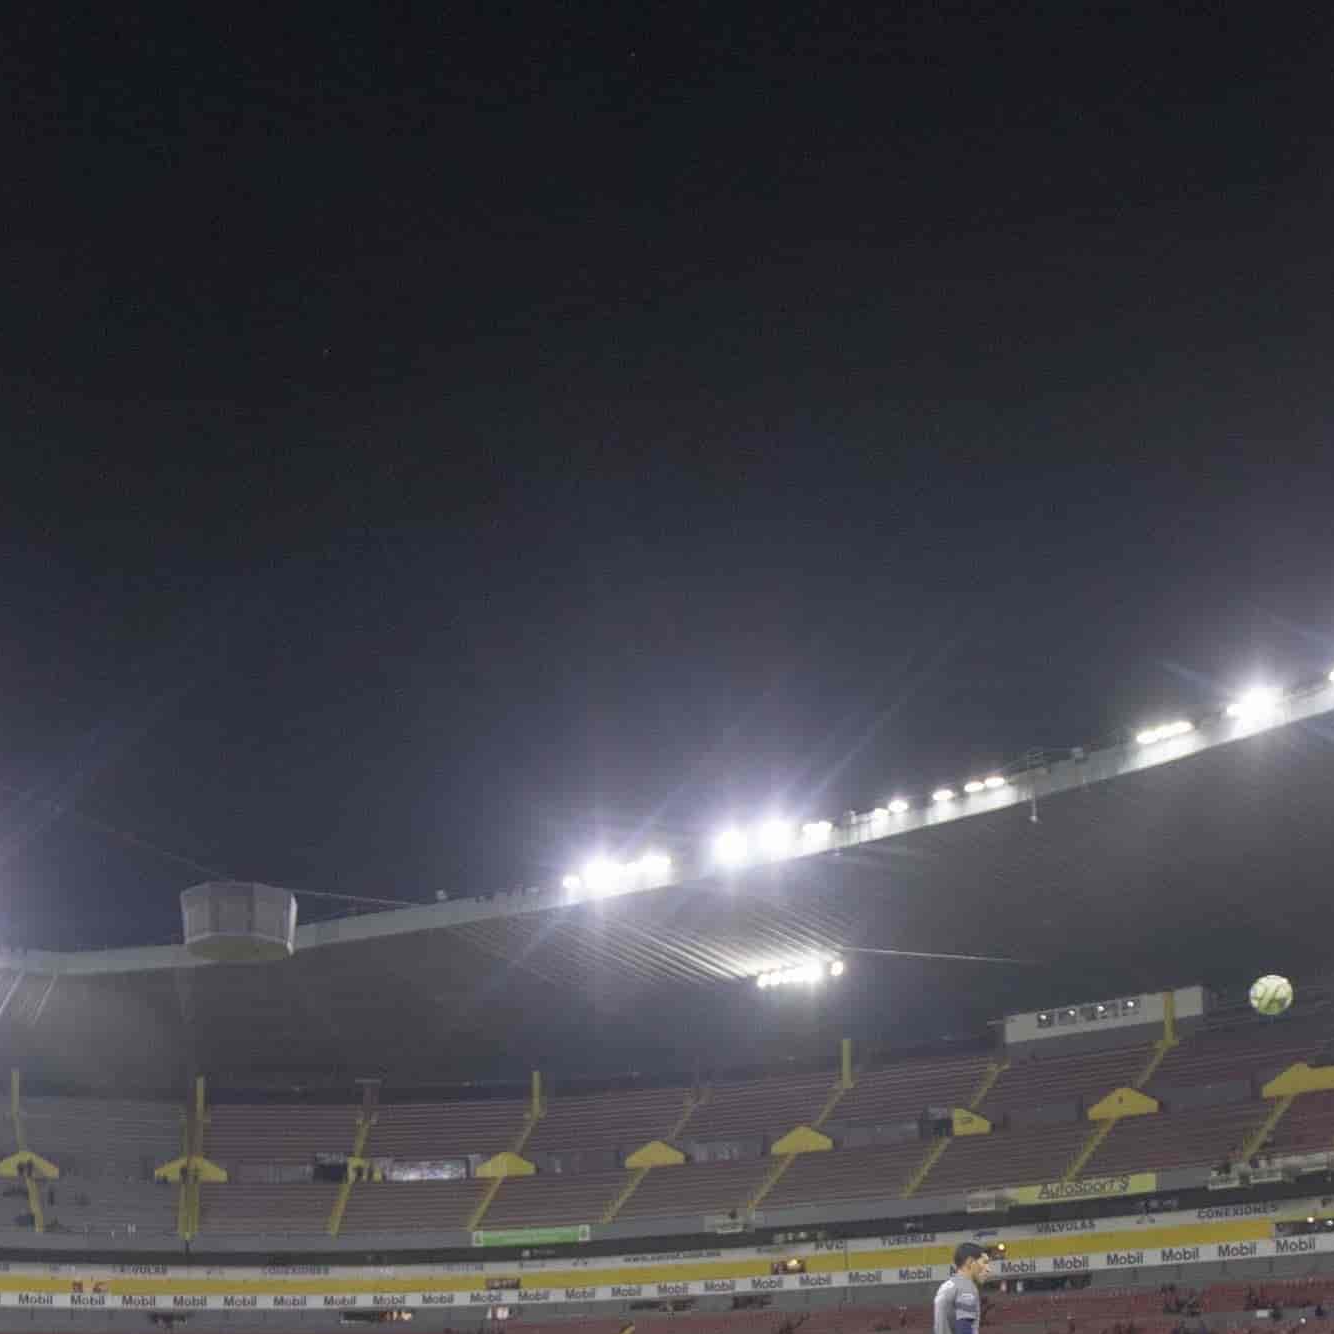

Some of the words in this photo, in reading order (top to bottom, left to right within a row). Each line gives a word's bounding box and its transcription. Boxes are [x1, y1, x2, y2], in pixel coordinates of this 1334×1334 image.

[18, 1292, 54, 1306] Mobil
[70, 1293, 105, 1306] Mobil
[122, 1294, 156, 1307] Mobil
[173, 1294, 207, 1307] Mobil
[223, 1295, 257, 1307] Mobil
[273, 1295, 307, 1307] Mobil
[323, 1295, 357, 1306] Mobil
[373, 1294, 406, 1306] Mobil
[422, 1293, 454, 1305] Mobil
[611, 1285, 642, 1298] Mobil
[751, 1277, 784, 1290] Mobil
[799, 1274, 832, 1287] Mobil
[848, 1270, 883, 1284] Mobil
[898, 1267, 932, 1281] Mobil
[1000, 1259, 1036, 1274] Mobil
[1053, 1256, 1090, 1271] Mobil
[1106, 1252, 1144, 1266] Mobil
[1161, 1247, 1200, 1262] Mobil
[1218, 1242, 1257, 1257] Mobil
[1275, 1236, 1316, 1253] Mobil
